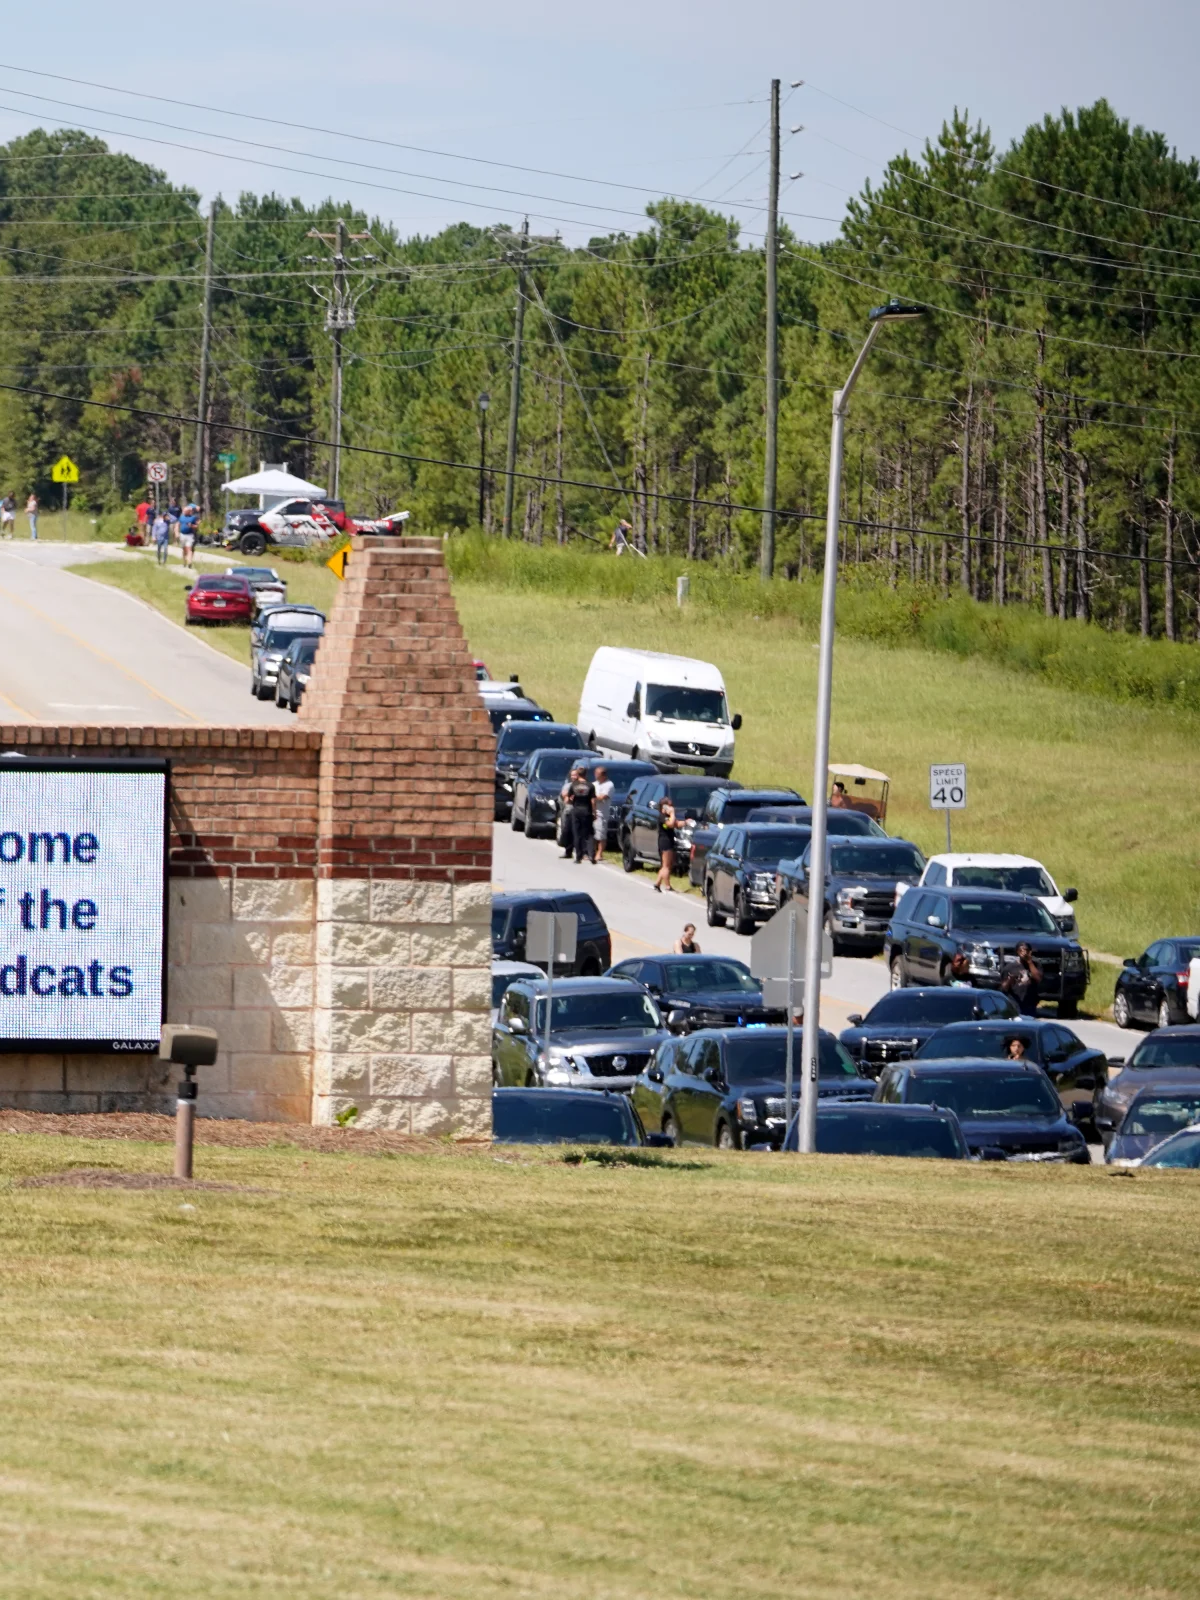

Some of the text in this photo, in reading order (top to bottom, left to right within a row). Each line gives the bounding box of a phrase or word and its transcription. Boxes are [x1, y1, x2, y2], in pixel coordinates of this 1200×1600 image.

[932, 768, 963, 776] SPEED
[935, 777, 959, 785] LIMIT
[932, 786, 964, 803] 40
[19, 887, 99, 930] the
[112, 1041, 157, 1050] GALAXY
